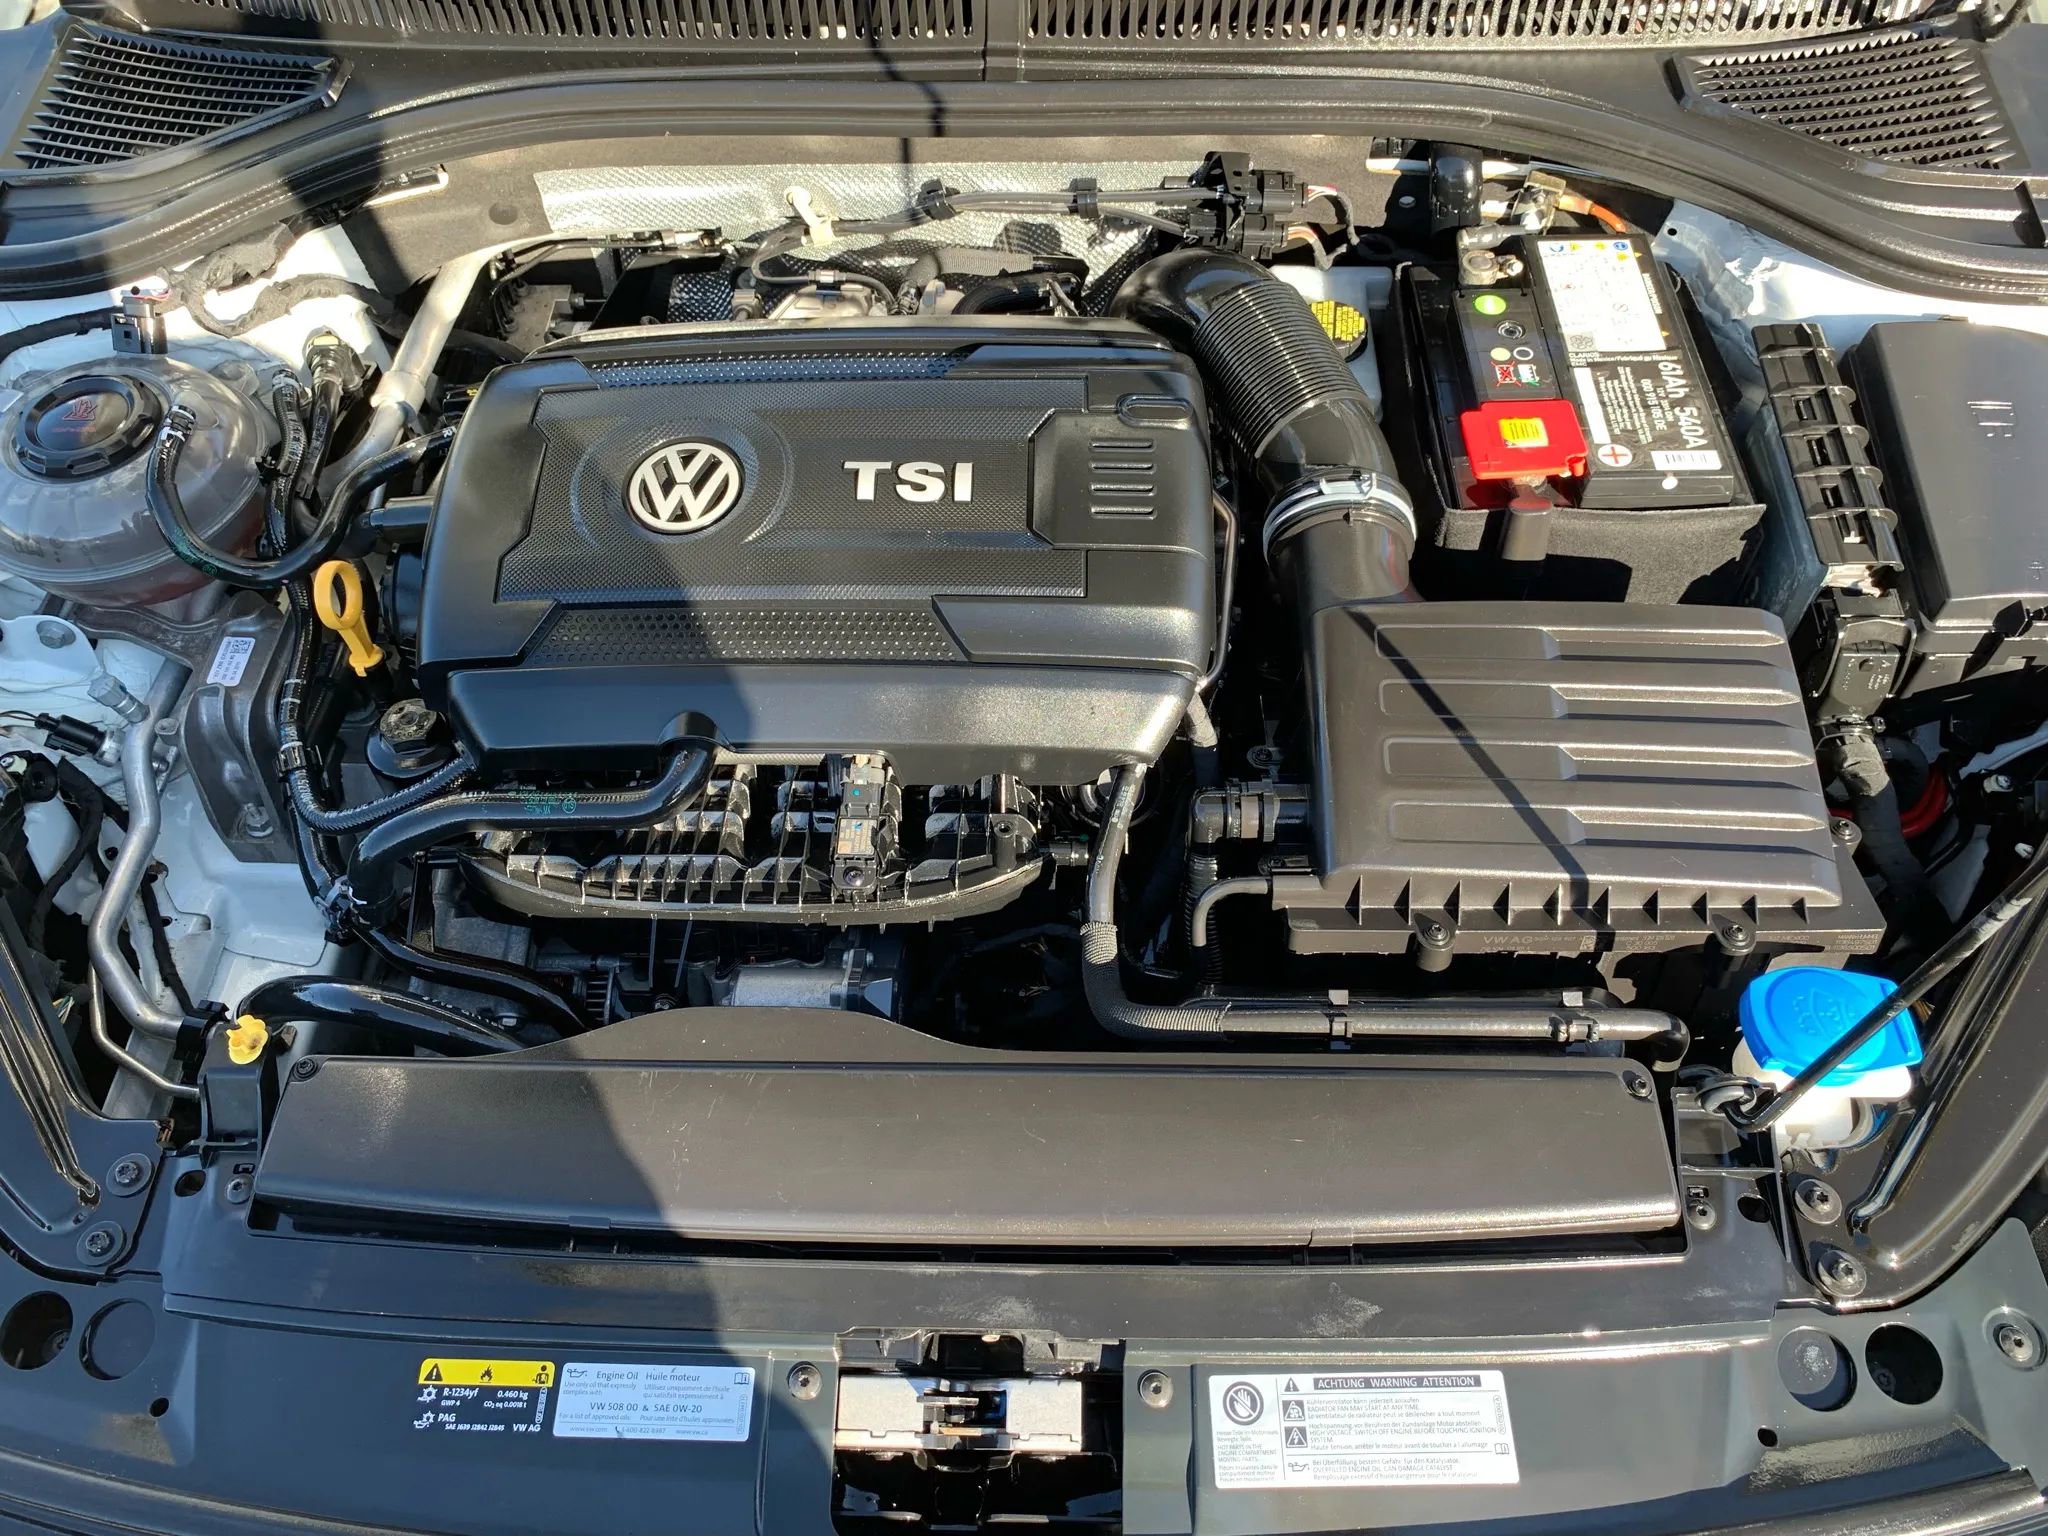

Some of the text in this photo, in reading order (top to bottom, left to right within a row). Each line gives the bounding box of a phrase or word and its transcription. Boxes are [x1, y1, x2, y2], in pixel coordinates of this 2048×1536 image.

[1658, 361, 1708, 448] 61Ah 540A
[628, 441, 742, 532] VW
[843, 460, 974, 502] TSI
[1483, 936, 1509, 944] VW
[1510, 935, 1533, 944] AG
[596, 1371, 700, 1382] Engine Oil Huile moteur
[1318, 1377, 1475, 1389] ACHTUNG WARNING ATTENTION
[443, 1388, 529, 1400] R-1234yf 0.460 kg
[590, 1402, 606, 1411] VW
[608, 1402, 624, 1411] 508
[626, 1403, 639, 1411] 00
[654, 1403, 671, 1412] SAE
[672, 1404, 703, 1413] 0W-20
[438, 1413, 456, 1422] PAG
[513, 1424, 526, 1432] VW
[527, 1424, 540, 1432] AG
